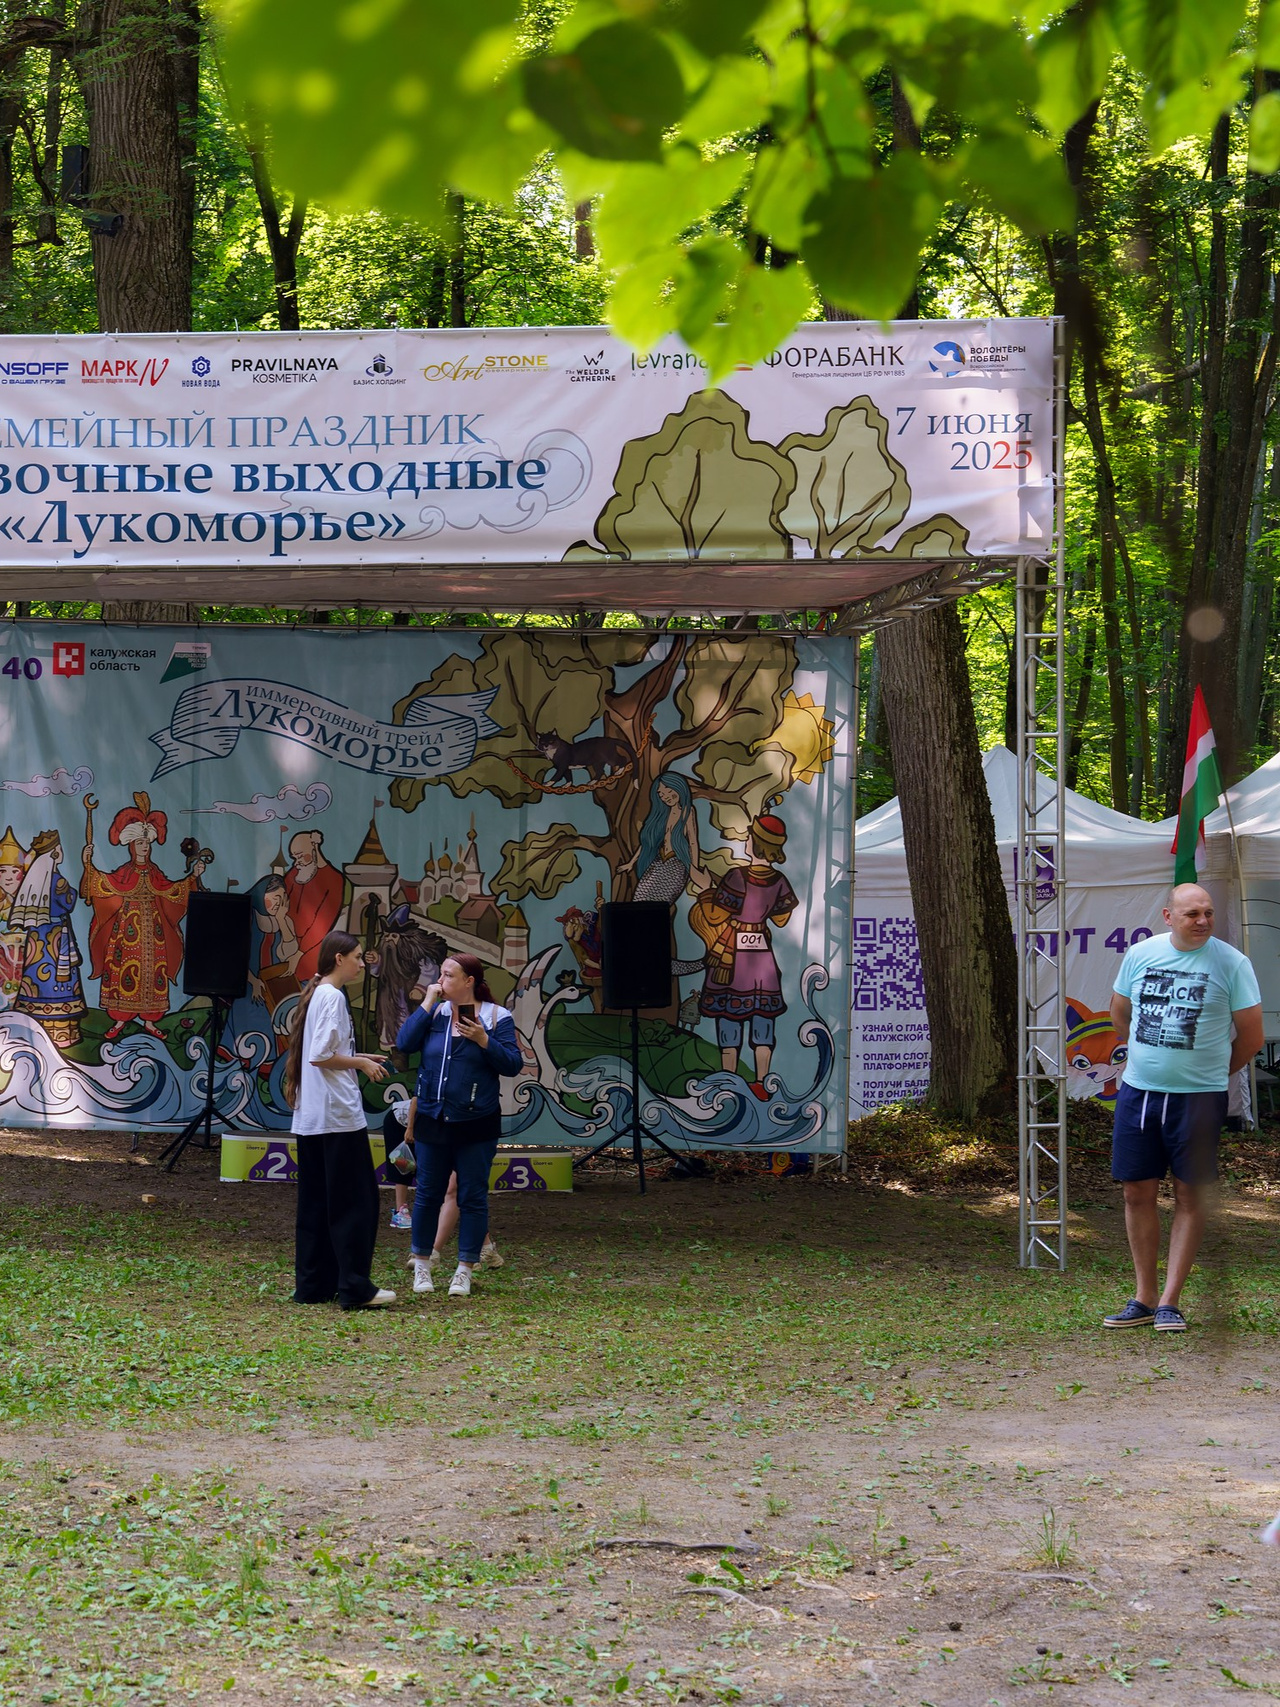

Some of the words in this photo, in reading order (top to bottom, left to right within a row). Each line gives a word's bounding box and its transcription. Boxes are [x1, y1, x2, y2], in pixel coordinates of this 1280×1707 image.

[763, 346, 905, 368] ФОРАБАНК
[970, 345, 1026, 354] ВОЛОНТЁРЫ
[81, 360, 138, 376] МАРК
[231, 357, 339, 372] PRAVILNAYA
[420, 355, 485, 381] Art
[484, 355, 549, 367] STONE
[576, 368, 610, 376] WELDER
[181, 379, 202, 388] НОВАЯ
[203, 379, 221, 388] ВОДА
[252, 373, 318, 383] KOSMETIKA
[570, 375, 616, 383] CATHERINE
[894, 407, 917, 435] 7
[227, 413, 486, 454] ПРАЗДНИК
[950, 440, 1033, 471] 2025
[230, 458, 547, 499] выходные
[89, 647, 157, 660] калужская
[1, 656, 43, 680] 40
[89, 660, 141, 672] область
[245, 684, 380, 738] иммерсивный
[384, 728, 446, 748] трейл
[209, 689, 443, 774] Лукоморье
[740, 934, 762, 945] 001
[1142, 982, 1198, 1002] BLACK
[1140, 1003, 1197, 1020] WHITE
[862, 1022, 893, 1032] УЗНАЙ
[896, 1024, 903, 1032] О
[862, 1031, 924, 1042] КАЛУЖСКОЙ
[863, 1053, 901, 1061] ОПЛАТИ
[904, 1052, 929, 1061] СЛОТ
[863, 1061, 921, 1071] ПЛАТФОРМЕ
[863, 1080, 902, 1089] ПОЛУЧИ
[863, 1090, 876, 1098] ИХ
[878, 1090, 884, 1098] В
[266, 1152, 288, 1179] 2
[512, 1165, 530, 1189] 3
